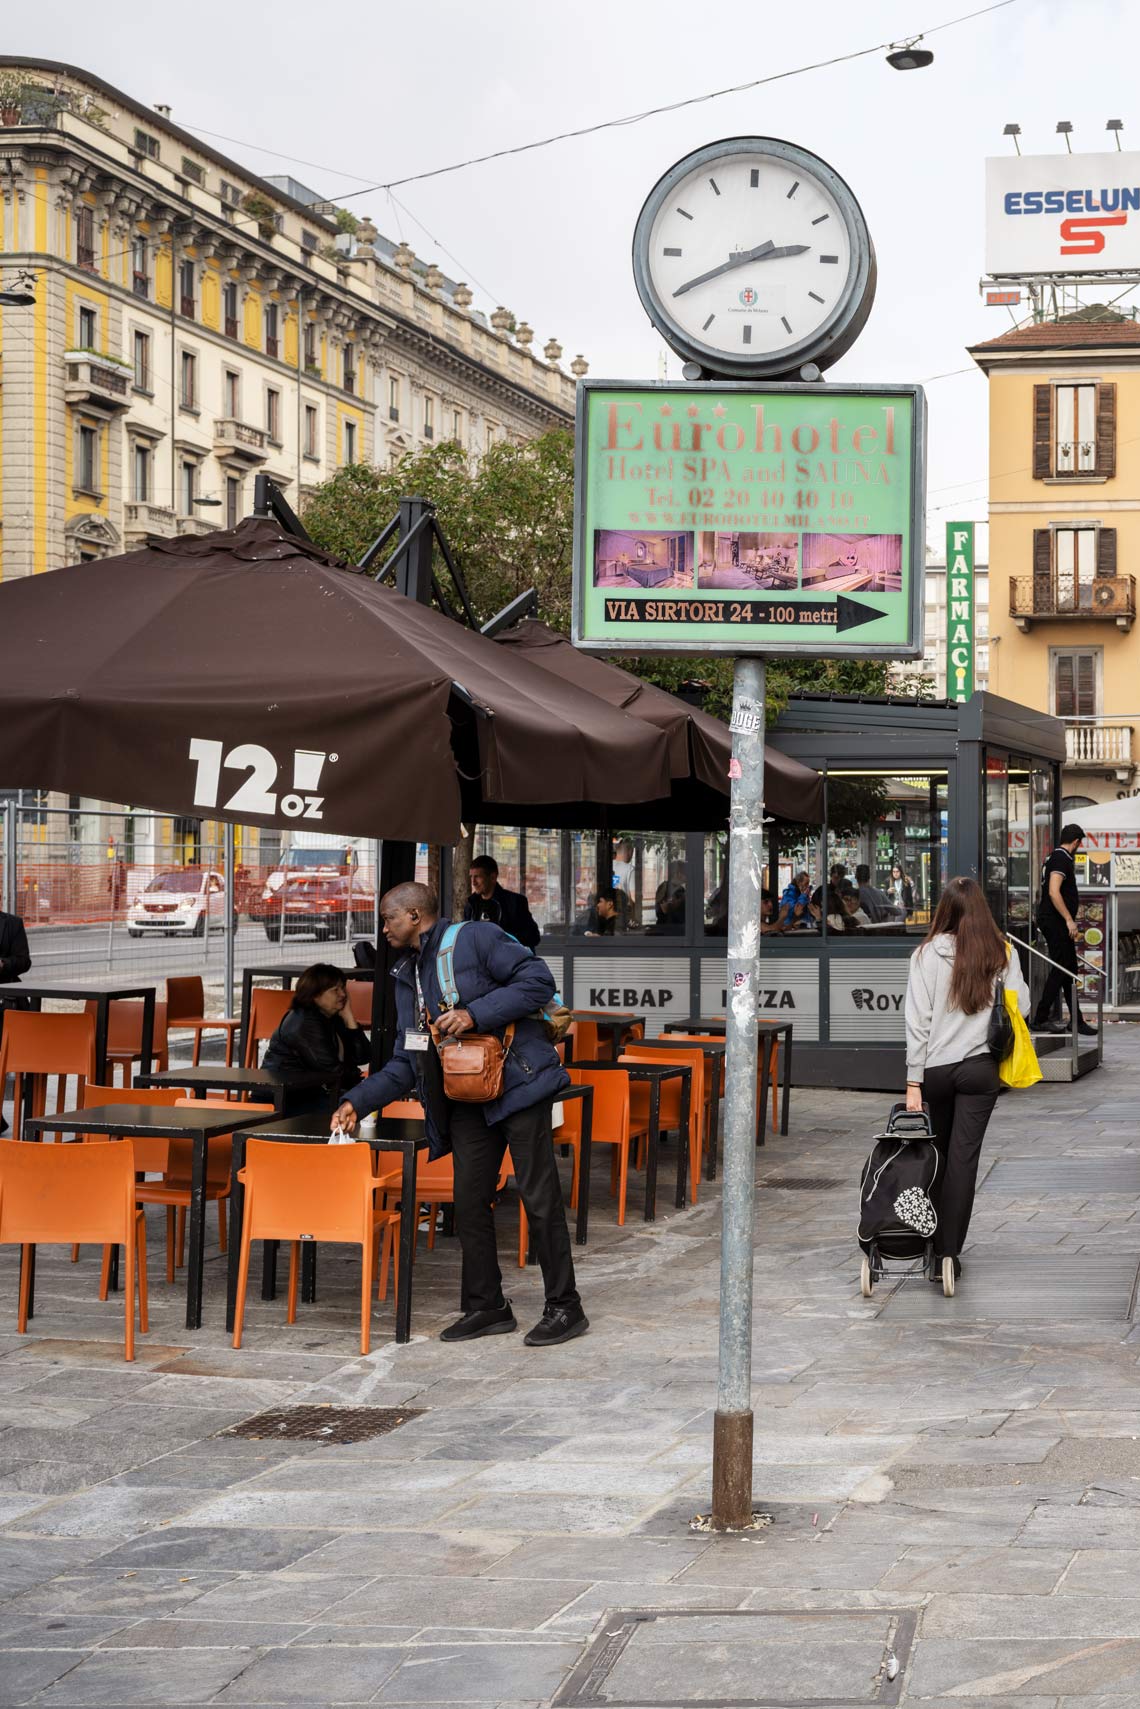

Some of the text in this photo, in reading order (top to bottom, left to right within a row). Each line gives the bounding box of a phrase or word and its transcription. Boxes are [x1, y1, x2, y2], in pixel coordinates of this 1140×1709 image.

[600, 401, 898, 455] Eurohotel
[607, 456, 891, 485] Hotel SPA and SAUNA
[645, 487, 681, 507] Tel.
[689, 488, 714, 508] 02
[723, 488, 749, 508] 20
[793, 490, 819, 509] 40
[606, 600, 642, 621] VIA
[645, 601, 724, 622] SIRTORI
[730, 604, 754, 622] 24
[768, 607, 795, 623] 100
[799, 608, 838, 624] metri
[590, 988, 673, 1007] KEBAP
